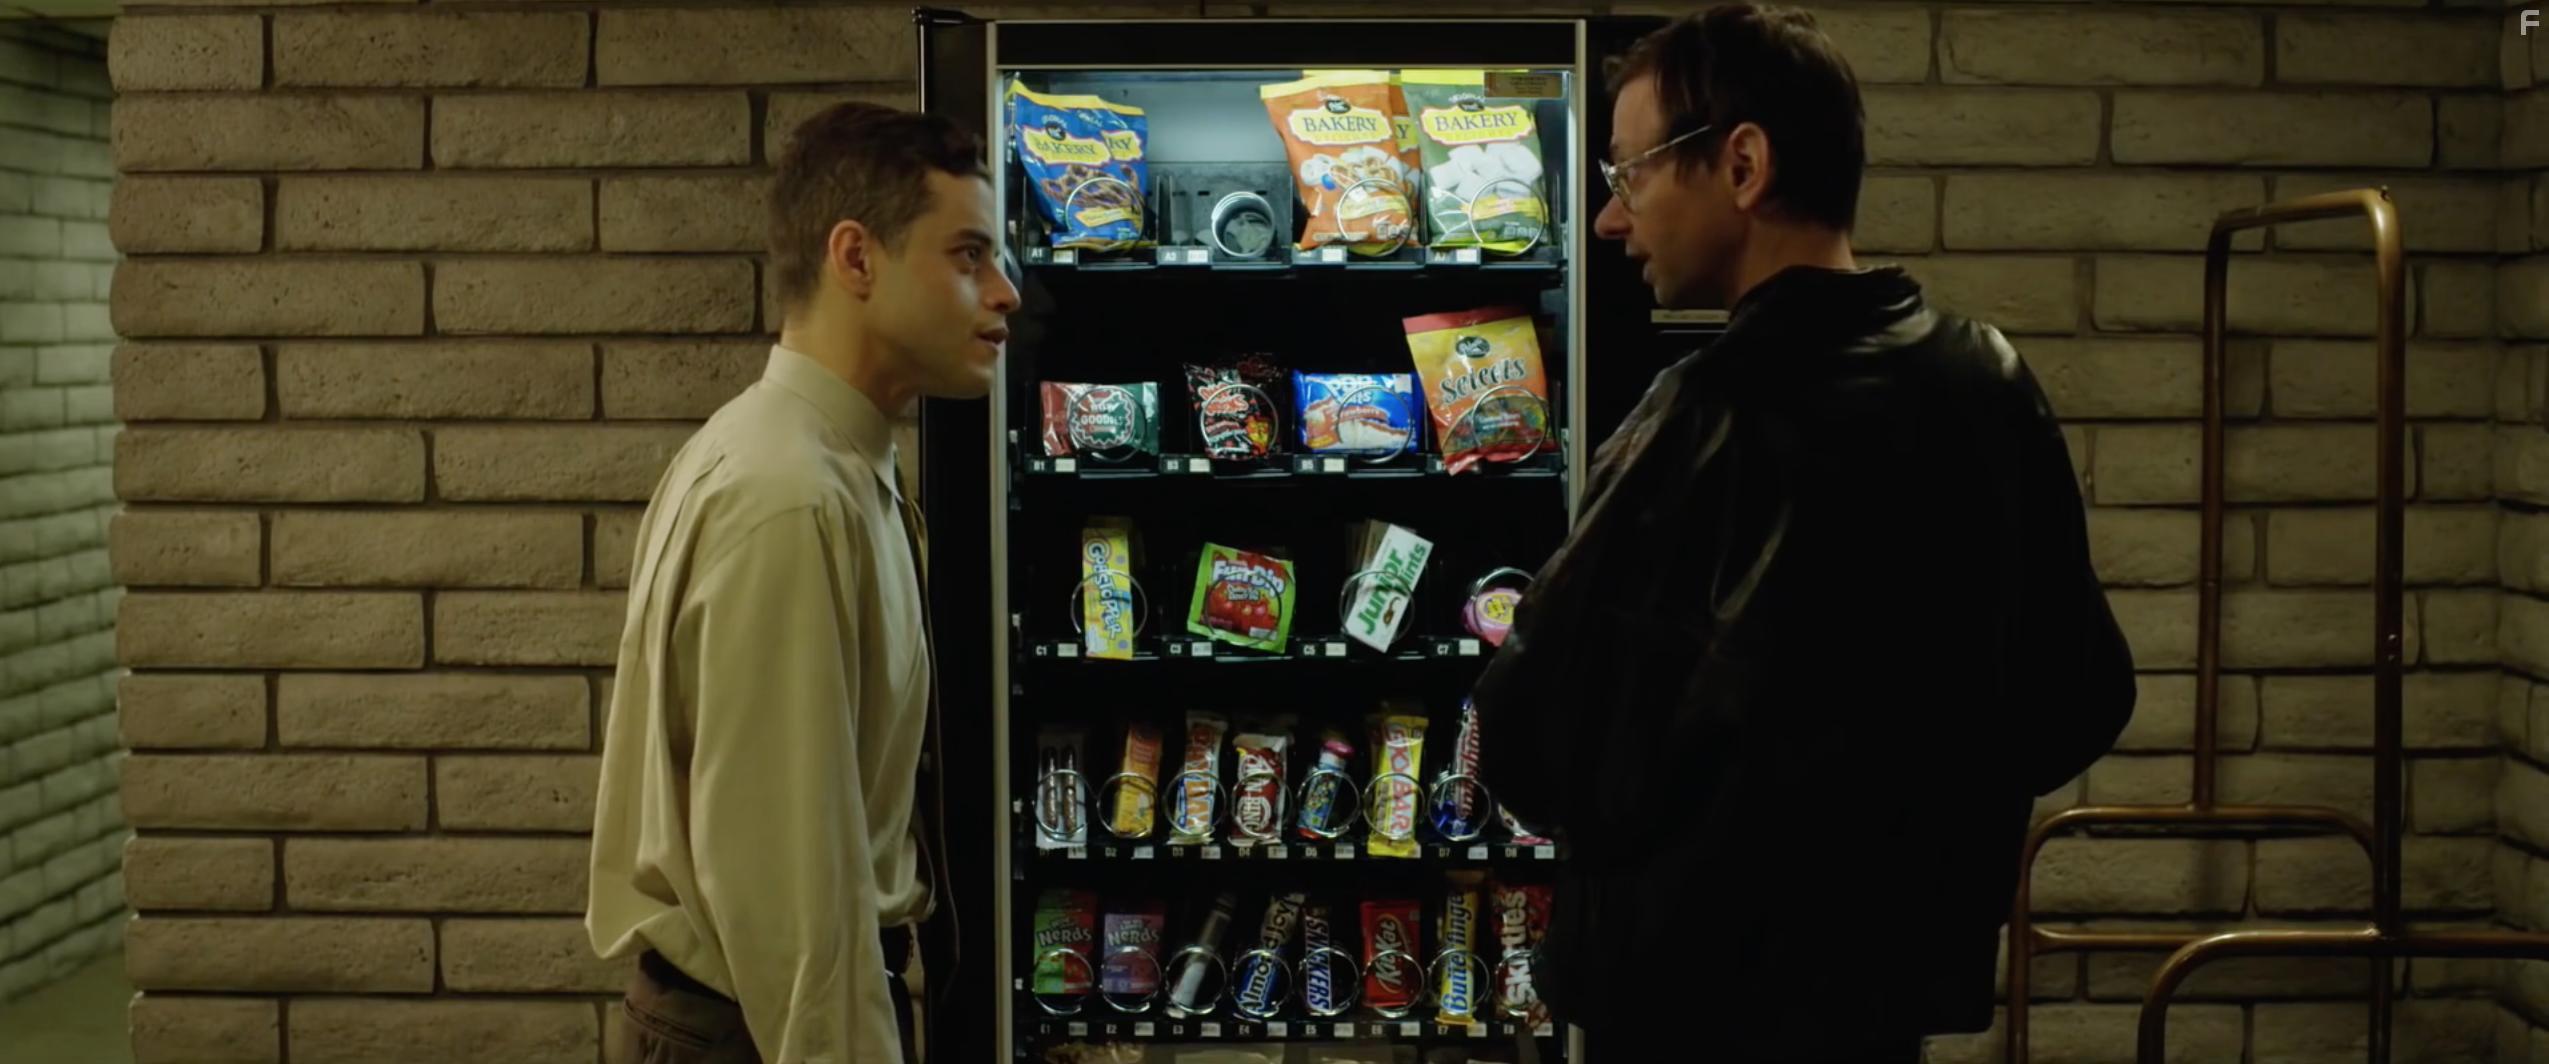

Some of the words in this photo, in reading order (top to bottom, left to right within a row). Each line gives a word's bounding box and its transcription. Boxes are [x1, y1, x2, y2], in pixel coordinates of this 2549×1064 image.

[1302, 117, 1377, 132] BAKERY
[1434, 112, 1518, 131] BAKERY
[1031, 248, 1042, 258] A1
[1440, 359, 1525, 403] Selects
[1358, 547, 1403, 636] Junior
[1036, 645, 1047, 656] C1
[1437, 644, 1449, 655] C7
[1238, 846, 1250, 857] D4
[1439, 847, 1450, 858] D7
[1306, 918, 1330, 1010] SNICKERS
[1106, 1023, 1117, 1034] E2
[1239, 1024, 1250, 1035] E4
[1438, 1024, 1449, 1035] E7
